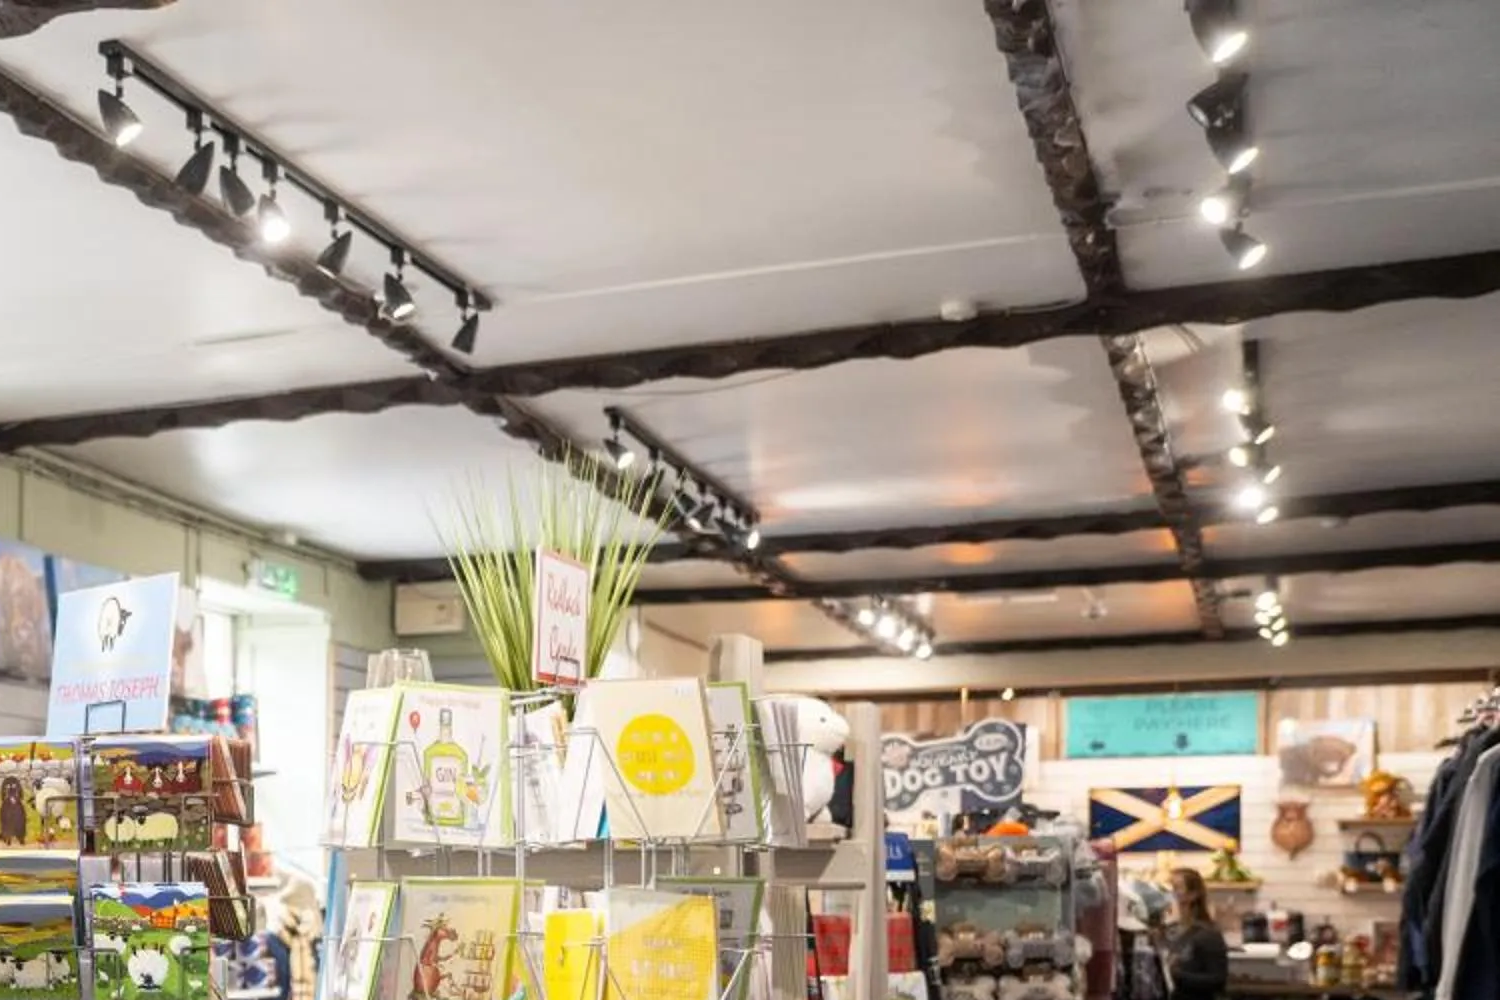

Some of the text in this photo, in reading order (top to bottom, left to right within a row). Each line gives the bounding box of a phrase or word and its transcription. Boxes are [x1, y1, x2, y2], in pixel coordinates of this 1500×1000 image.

[435, 766, 457, 784] GIN
[883, 751, 1009, 799] DOG TOY
